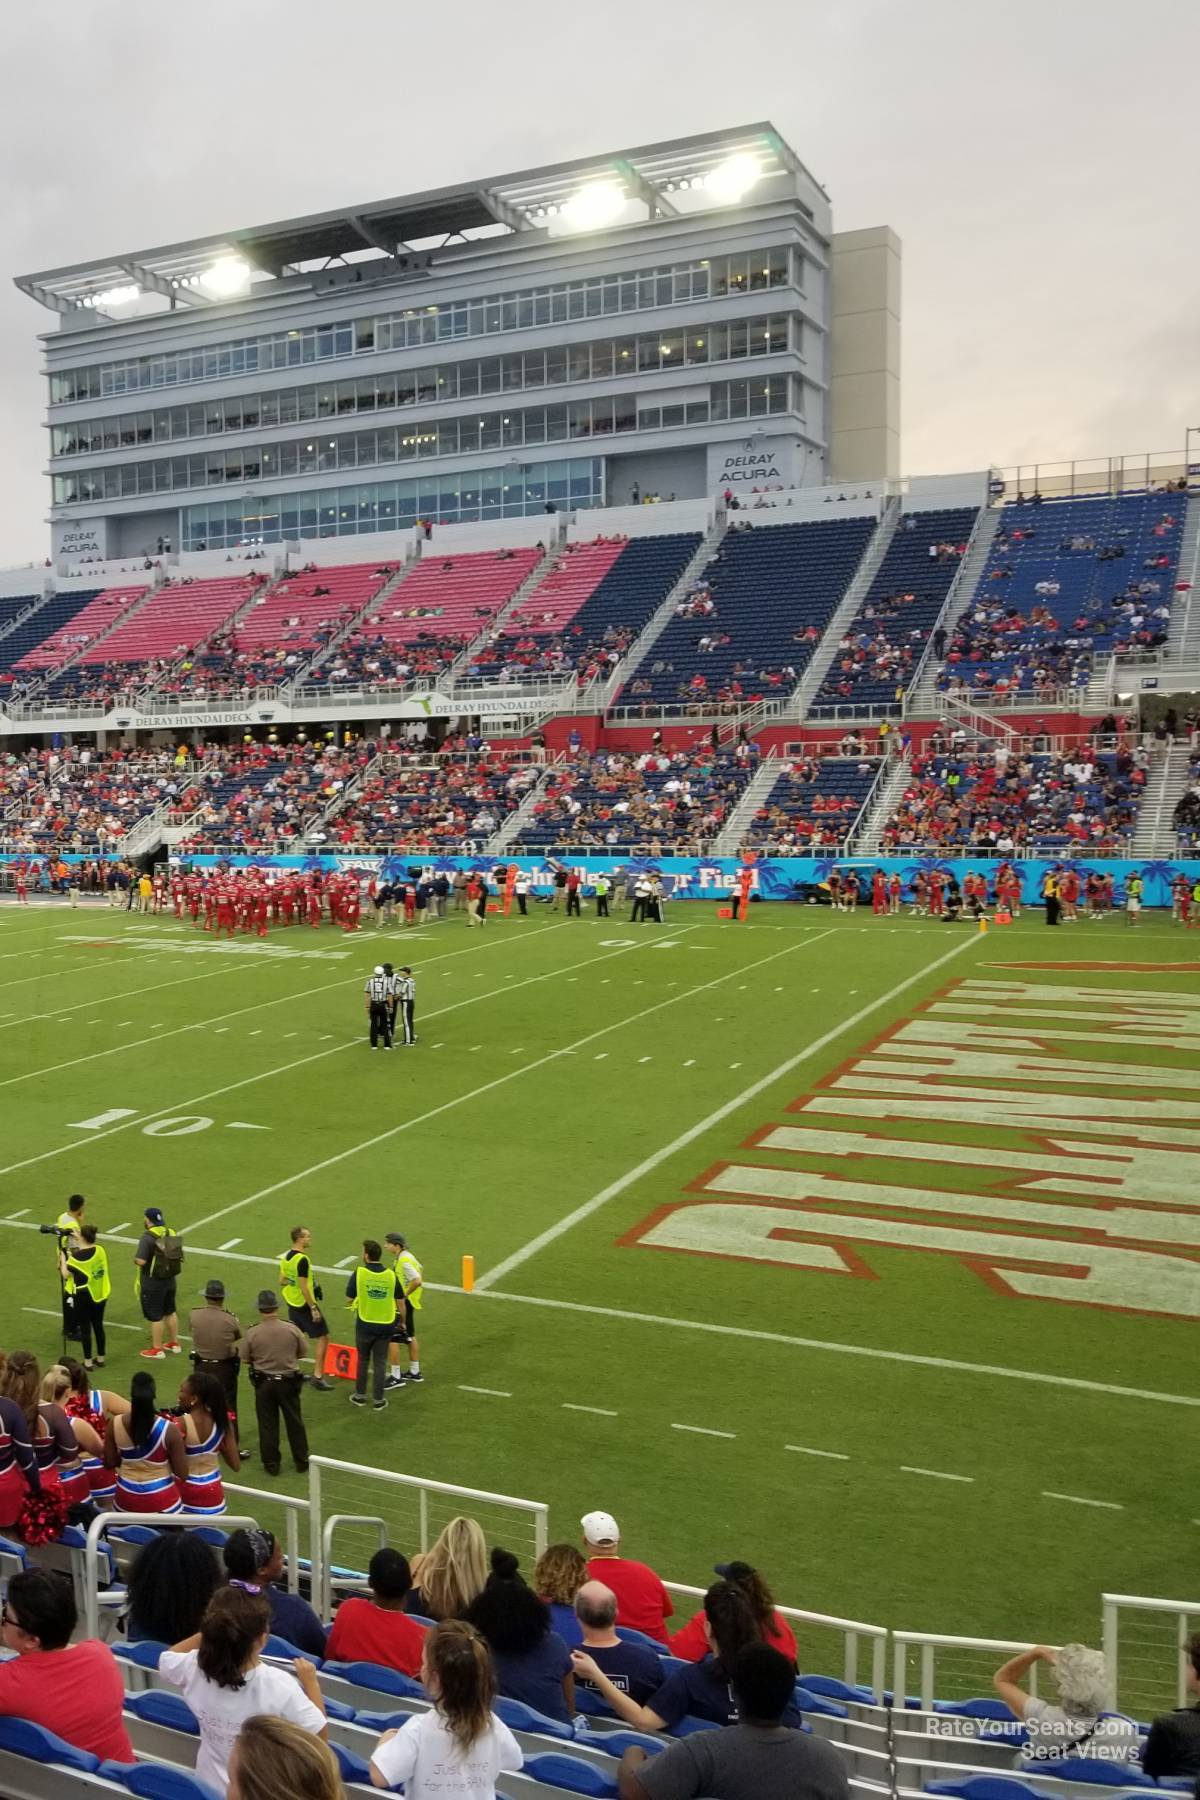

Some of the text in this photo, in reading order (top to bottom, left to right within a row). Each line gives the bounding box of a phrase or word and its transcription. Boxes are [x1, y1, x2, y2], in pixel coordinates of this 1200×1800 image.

[725, 453, 775, 467] DELRAY
[719, 468, 780, 482] ACURA
[64, 531, 96, 542] DELRAY
[60, 543, 99, 553] ACURA
[435, 704, 475, 714] DELRAY
[478, 702, 526, 712] HYUNDAI
[136, 713, 252, 727] DELRAY HYUNDAI DECK
[66, 1108, 214, 1136] 10
[336, 1350, 351, 1374] G
